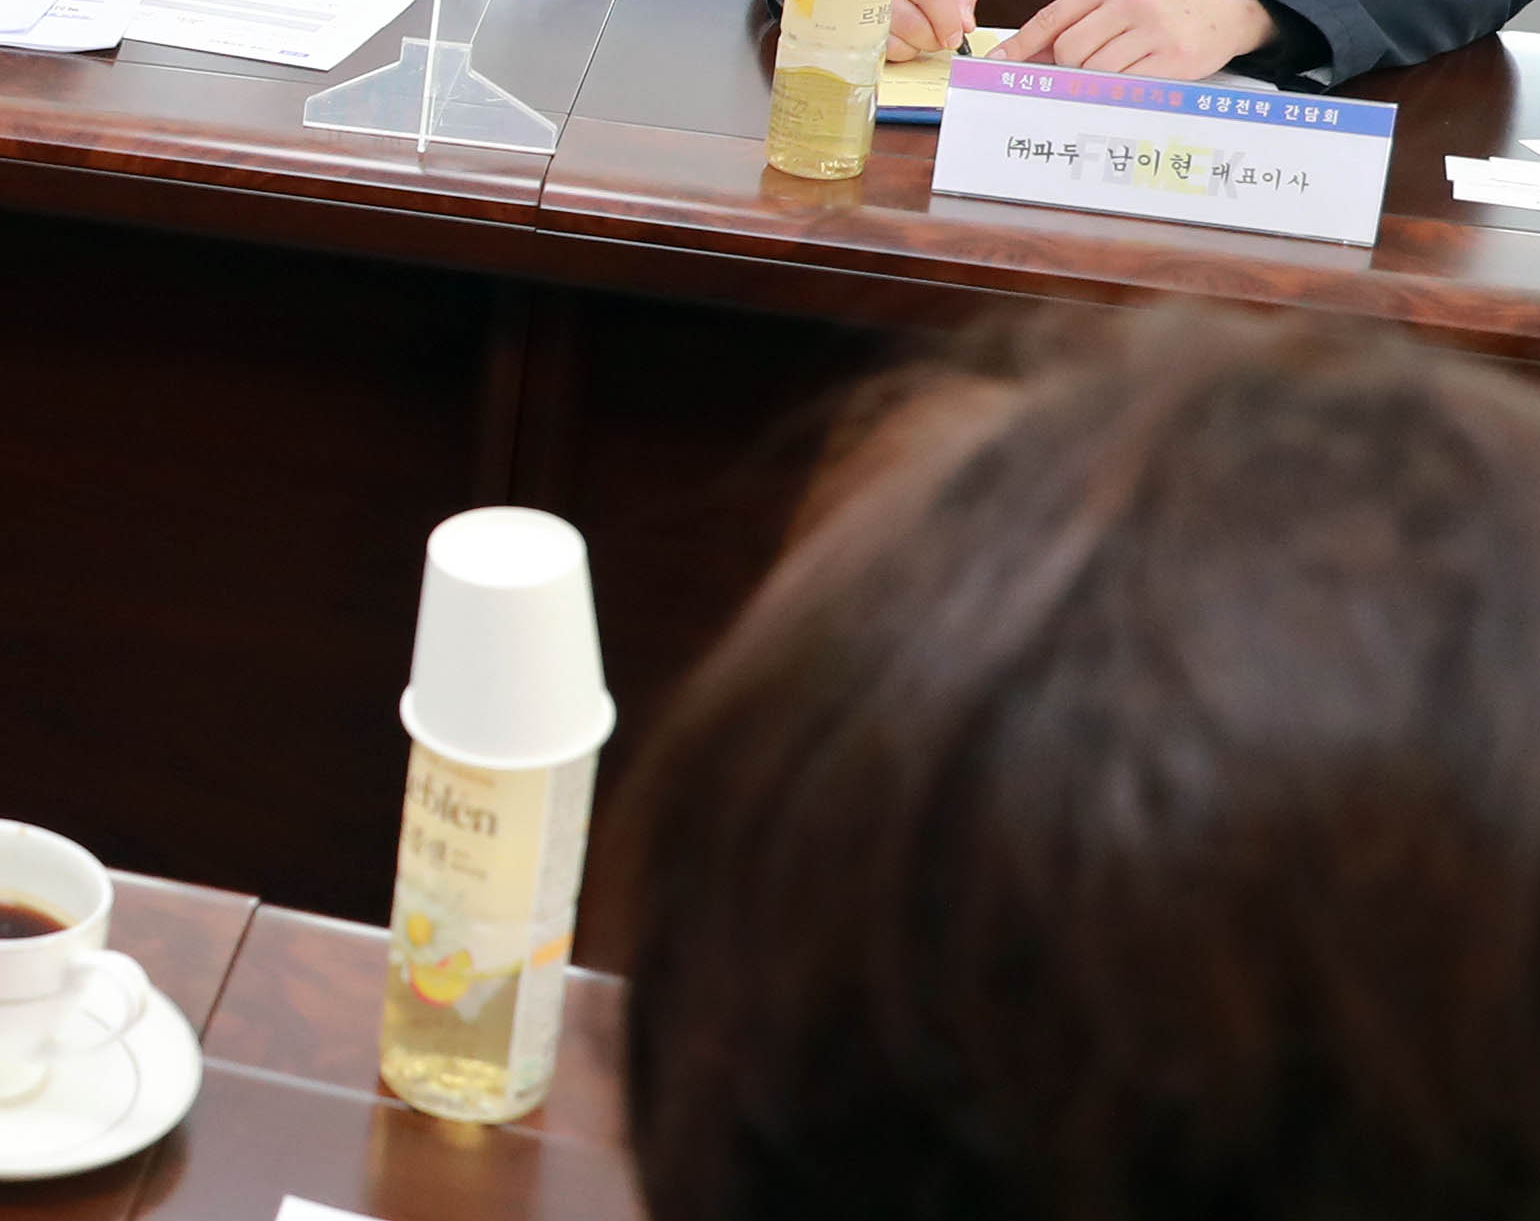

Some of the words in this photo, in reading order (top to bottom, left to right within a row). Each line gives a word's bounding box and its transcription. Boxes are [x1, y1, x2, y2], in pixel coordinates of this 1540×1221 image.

[1000, 71, 1055, 93] 혁신형
[1196, 93, 1273, 118] 성장전략
[1283, 102, 1340, 126] 간담회
[1107, 145, 1193, 180] 남이현
[1211, 162, 1310, 195] 대표이사
